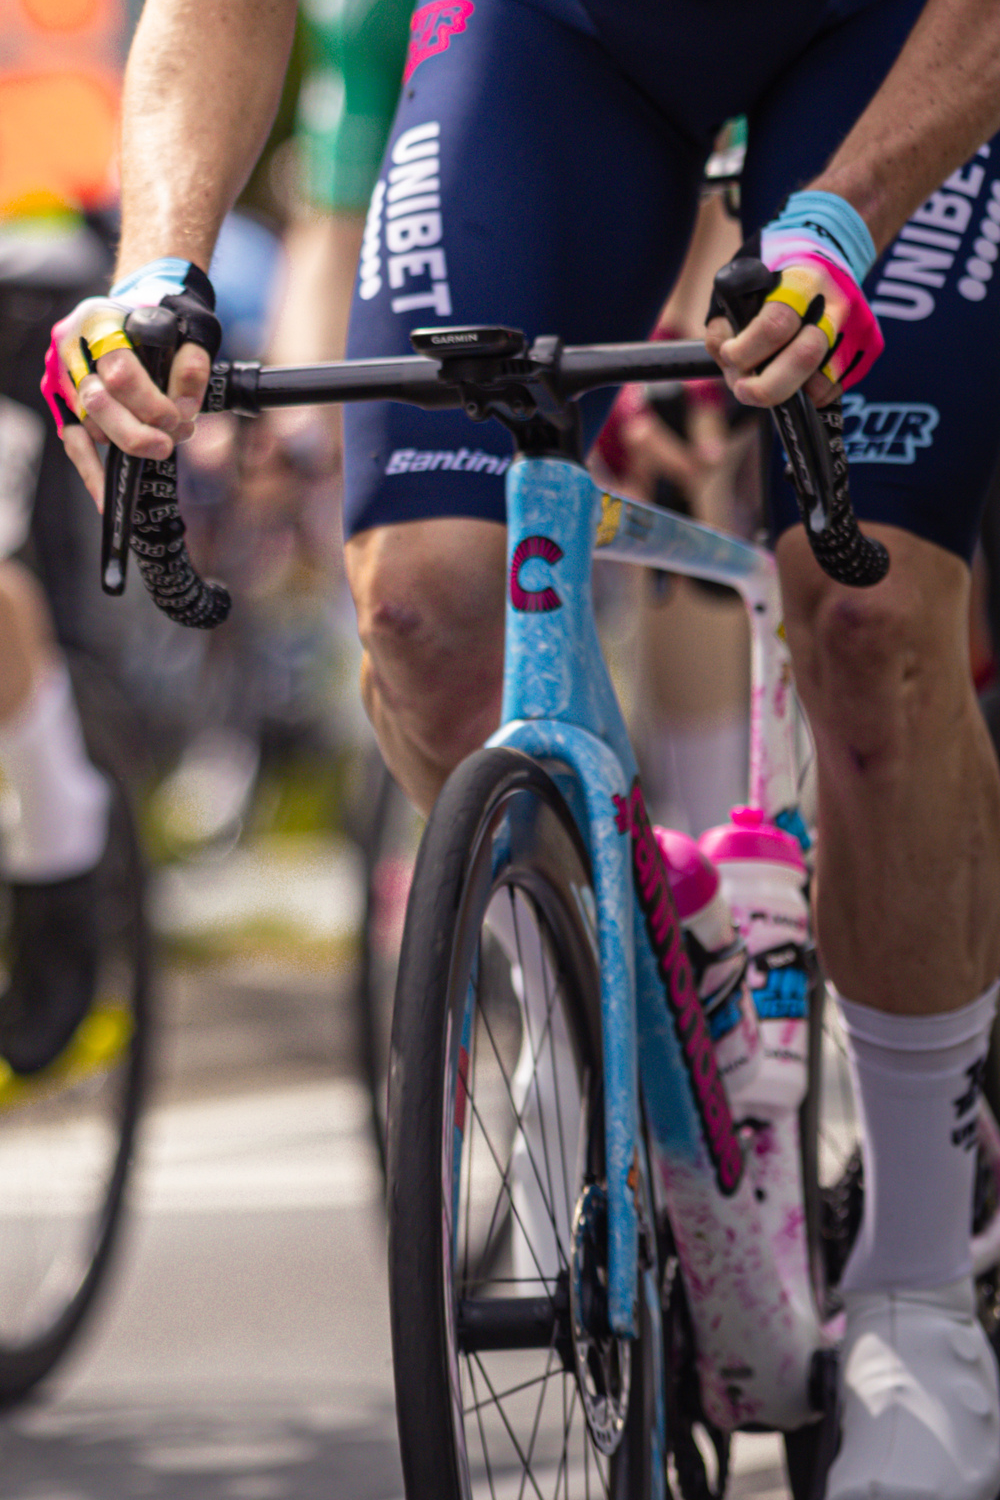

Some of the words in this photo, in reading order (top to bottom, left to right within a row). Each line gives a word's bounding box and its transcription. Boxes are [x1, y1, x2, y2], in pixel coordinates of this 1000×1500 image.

[386, 120, 452, 317] UNIBET
[869, 142, 991, 322] UNIBE
[431, 333, 479, 345] GARMIN
